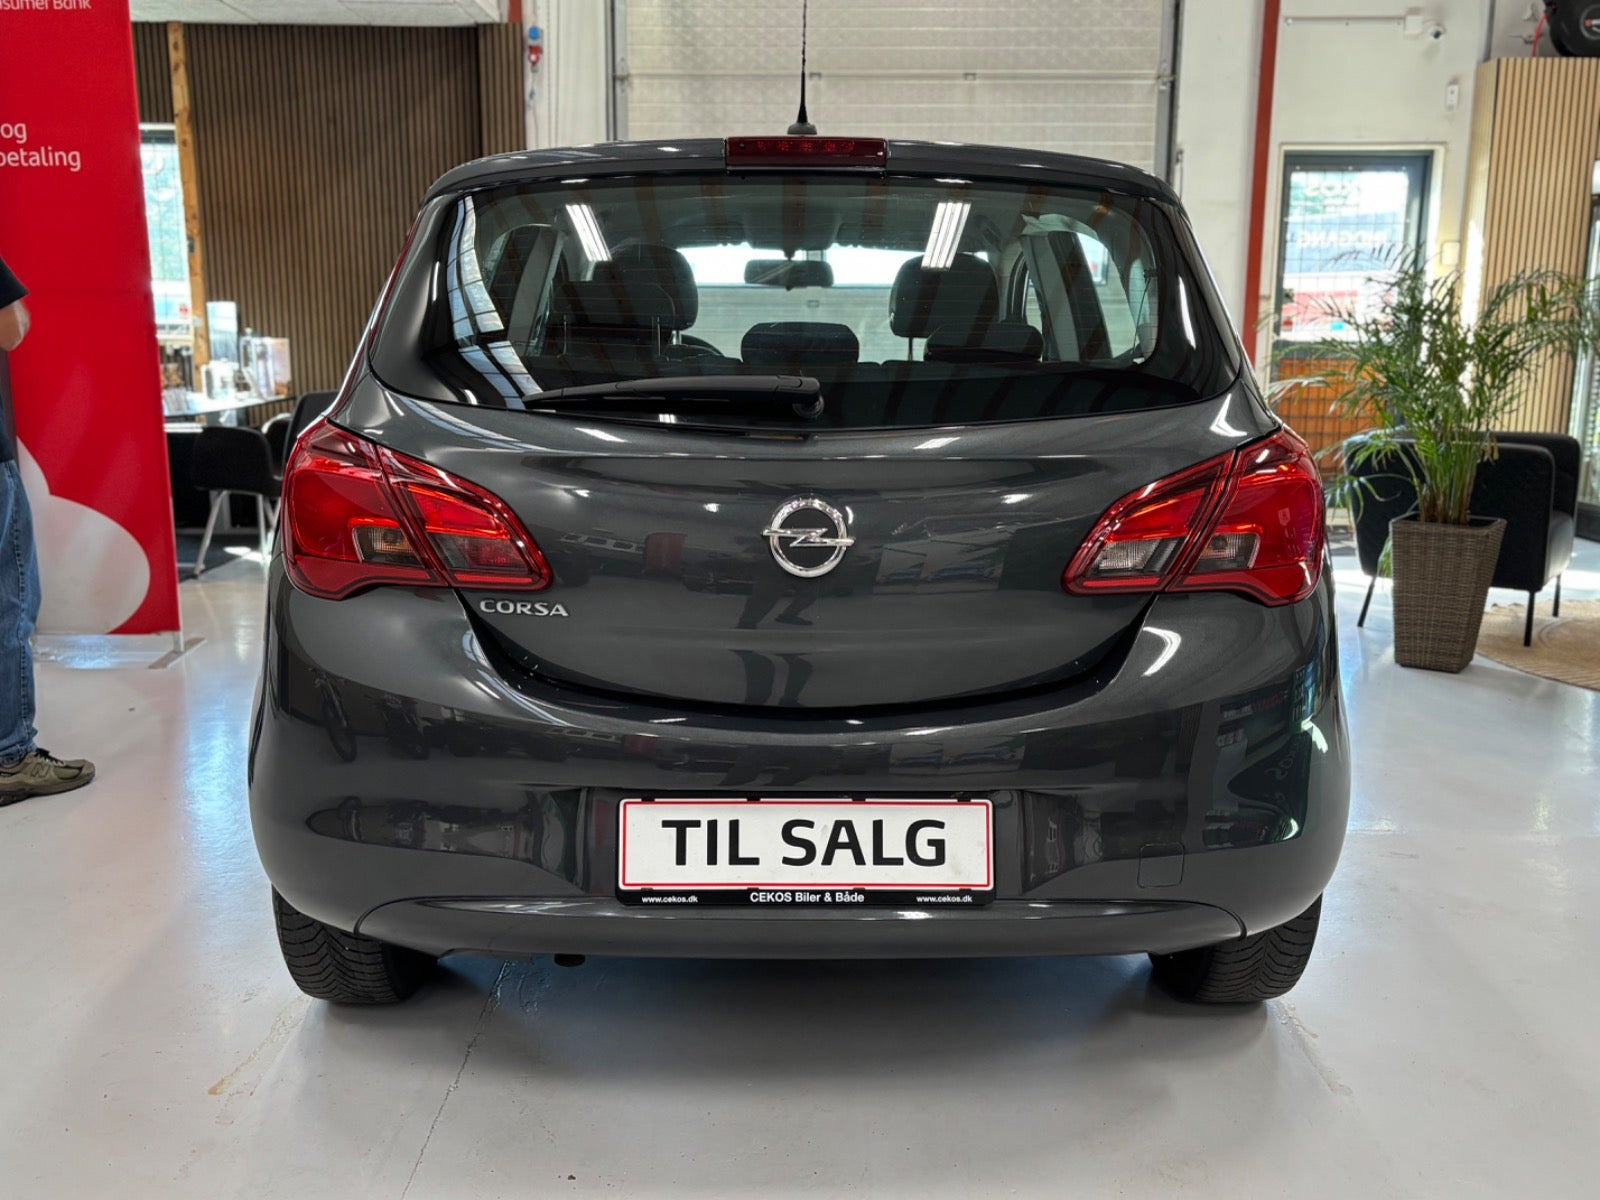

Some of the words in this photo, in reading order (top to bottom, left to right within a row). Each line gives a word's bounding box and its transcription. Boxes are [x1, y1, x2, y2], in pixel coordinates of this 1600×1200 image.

[53, 0, 91, 10] Bank
[0, 123, 27, 144] og
[480, 599, 569, 617] CORSA
[661, 818, 760, 866] TIL
[781, 818, 946, 867] SALG
[641, 895, 698, 903] www.cekos.dk
[750, 891, 792, 903] CEKOS
[795, 891, 821, 903] Biler
[824, 891, 832, 903] &
[836, 891, 865, 903] Både
[916, 895, 972, 903] www.cekos.dk
